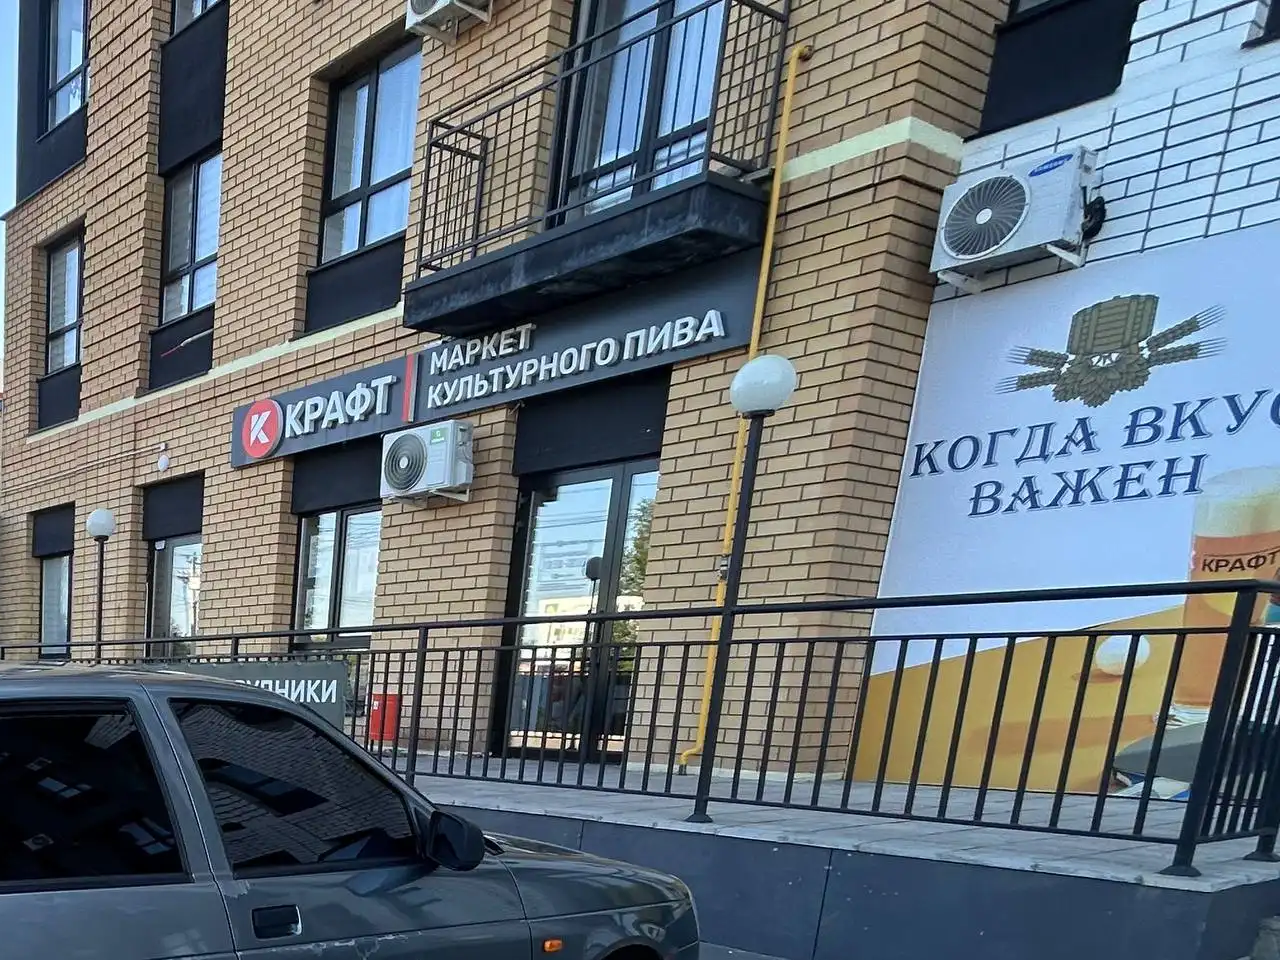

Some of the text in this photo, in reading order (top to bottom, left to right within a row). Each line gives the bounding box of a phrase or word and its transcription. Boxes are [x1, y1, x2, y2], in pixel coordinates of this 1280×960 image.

[427, 309, 725, 409] КУЛЬТУРНОГО ПИВА
[430, 322, 536, 376] МАРКЕТ
[285, 375, 397, 438] КРАФТ
[909, 388, 1280, 478] КОГДА ВКУ
[968, 453, 1209, 517] ВАЖЕН
